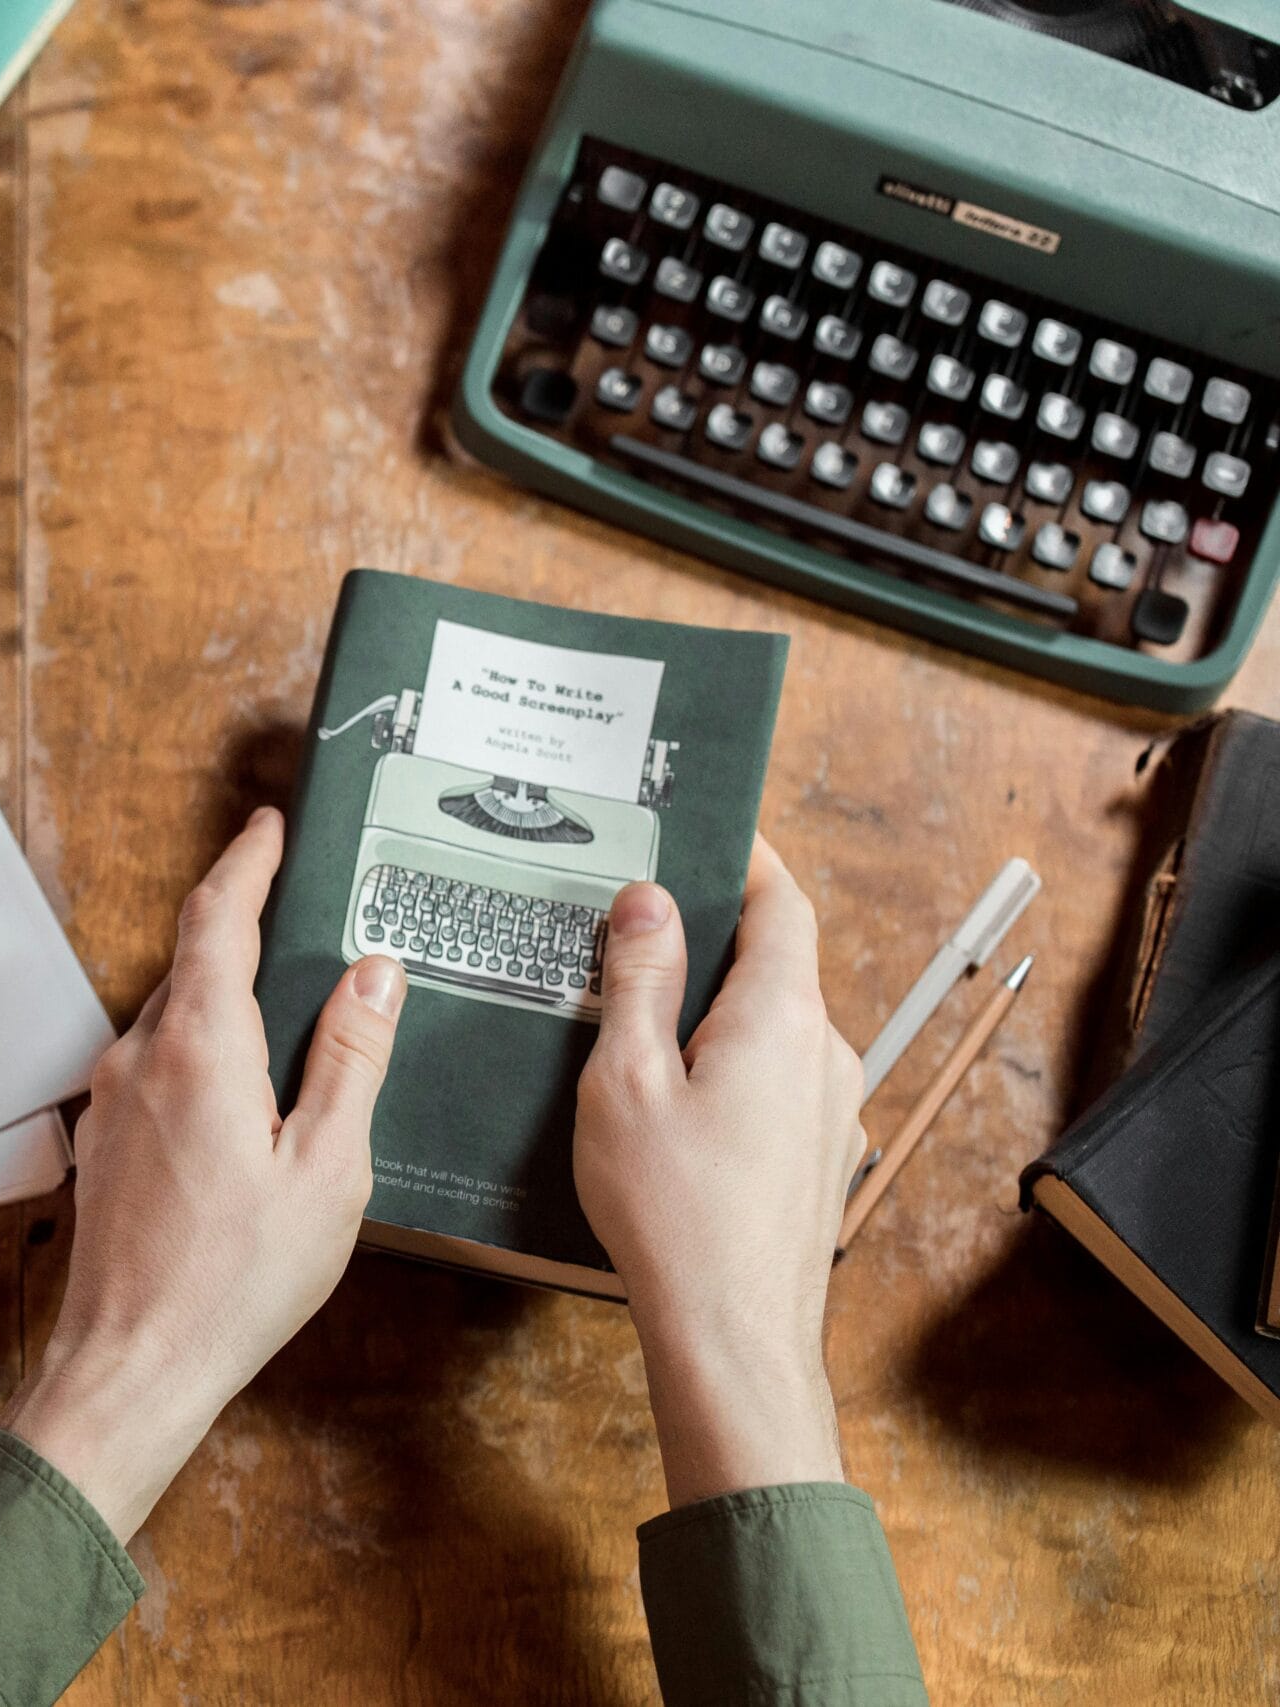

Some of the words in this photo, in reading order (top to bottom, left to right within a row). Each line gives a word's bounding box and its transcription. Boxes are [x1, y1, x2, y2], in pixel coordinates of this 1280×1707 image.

[451, 679, 462, 692] A
[470, 683, 510, 703] Good
[525, 678, 546, 693] To
[554, 684, 604, 703] Write
[484, 735, 530, 756] Angela
[535, 745, 574, 763] Scott
[548, 733, 566, 750] by
[374, 1156, 403, 1171] book
[406, 1163, 427, 1177] that
[430, 1168, 447, 1181] will
[450, 1172, 474, 1188] help
[475, 1179, 497, 1192] you
[372, 1172, 411, 1189] raceful
[412, 1180, 434, 1194] and
[436, 1186, 480, 1206] exciting
